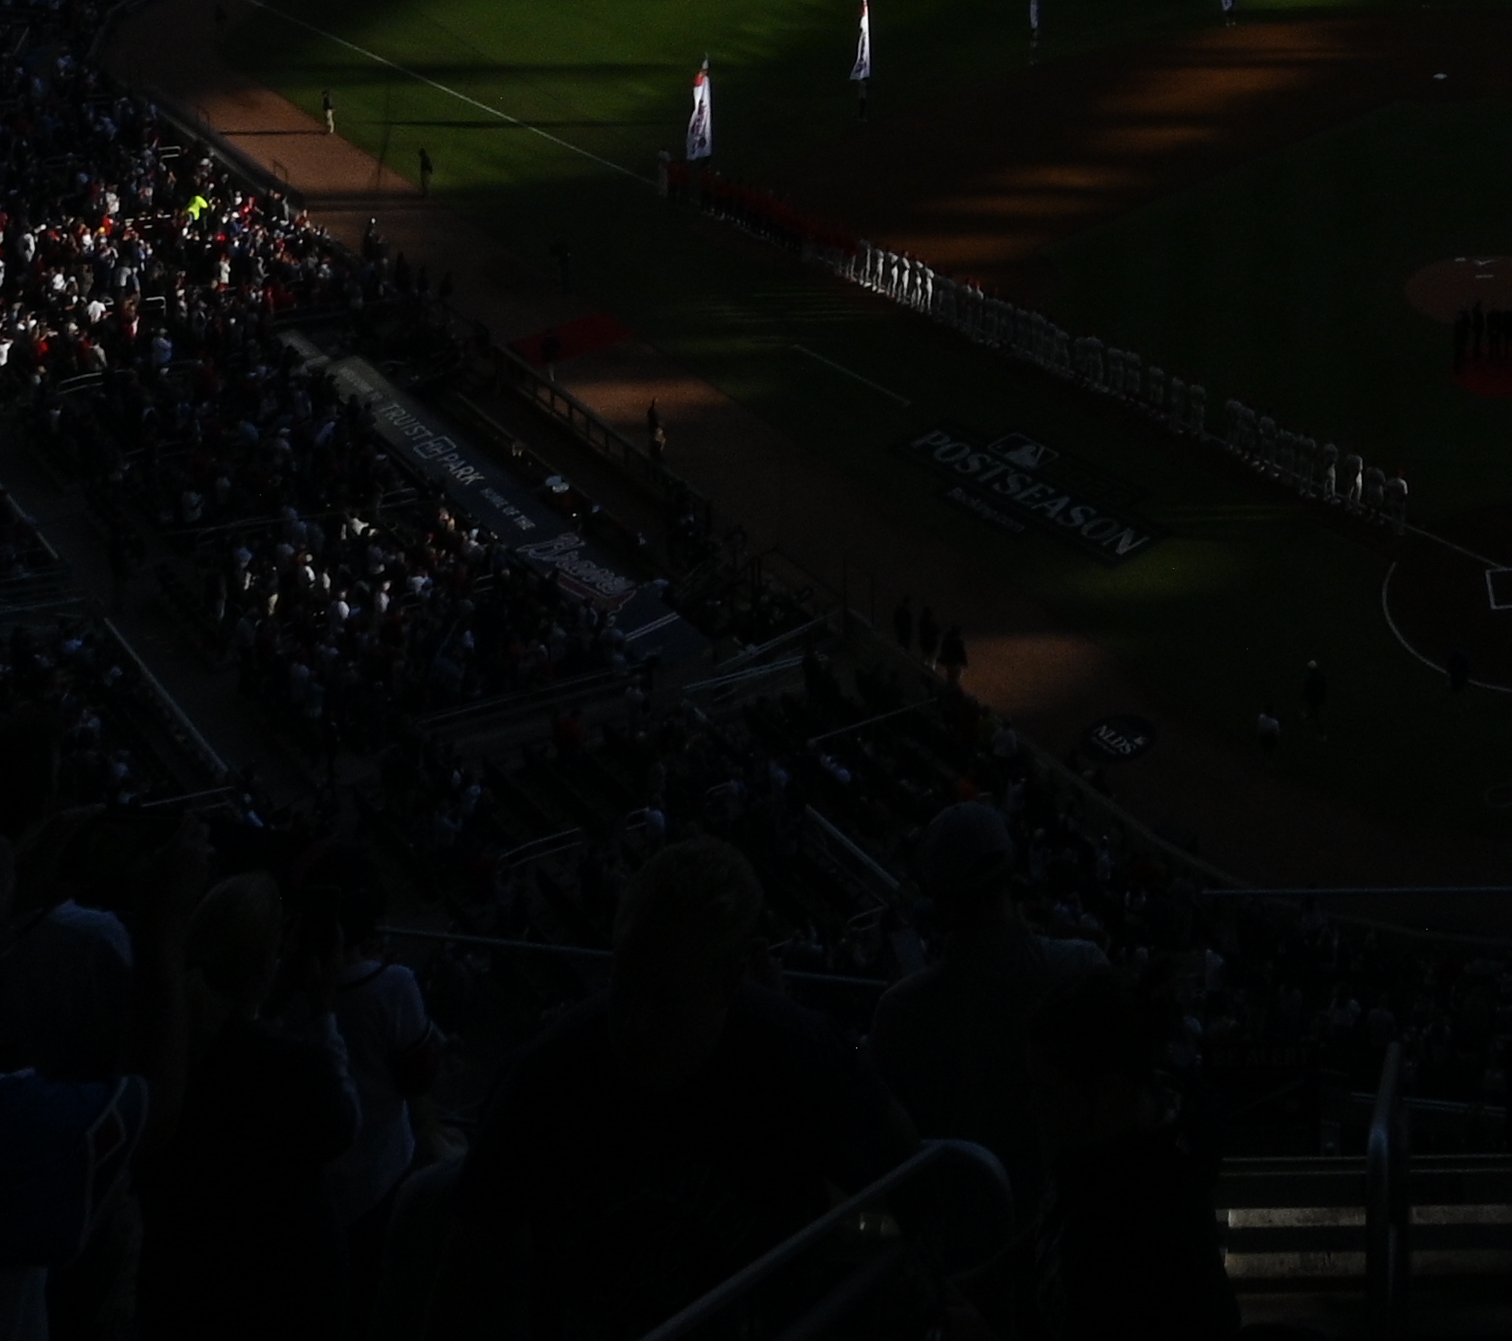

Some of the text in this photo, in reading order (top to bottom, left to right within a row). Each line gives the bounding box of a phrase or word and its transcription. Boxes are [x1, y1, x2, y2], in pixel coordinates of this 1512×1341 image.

[910, 429, 1150, 556] POSTSEASON
[1093, 724, 1132, 755] NLDS
[1211, 1045, 1310, 1068] BE ALERT
